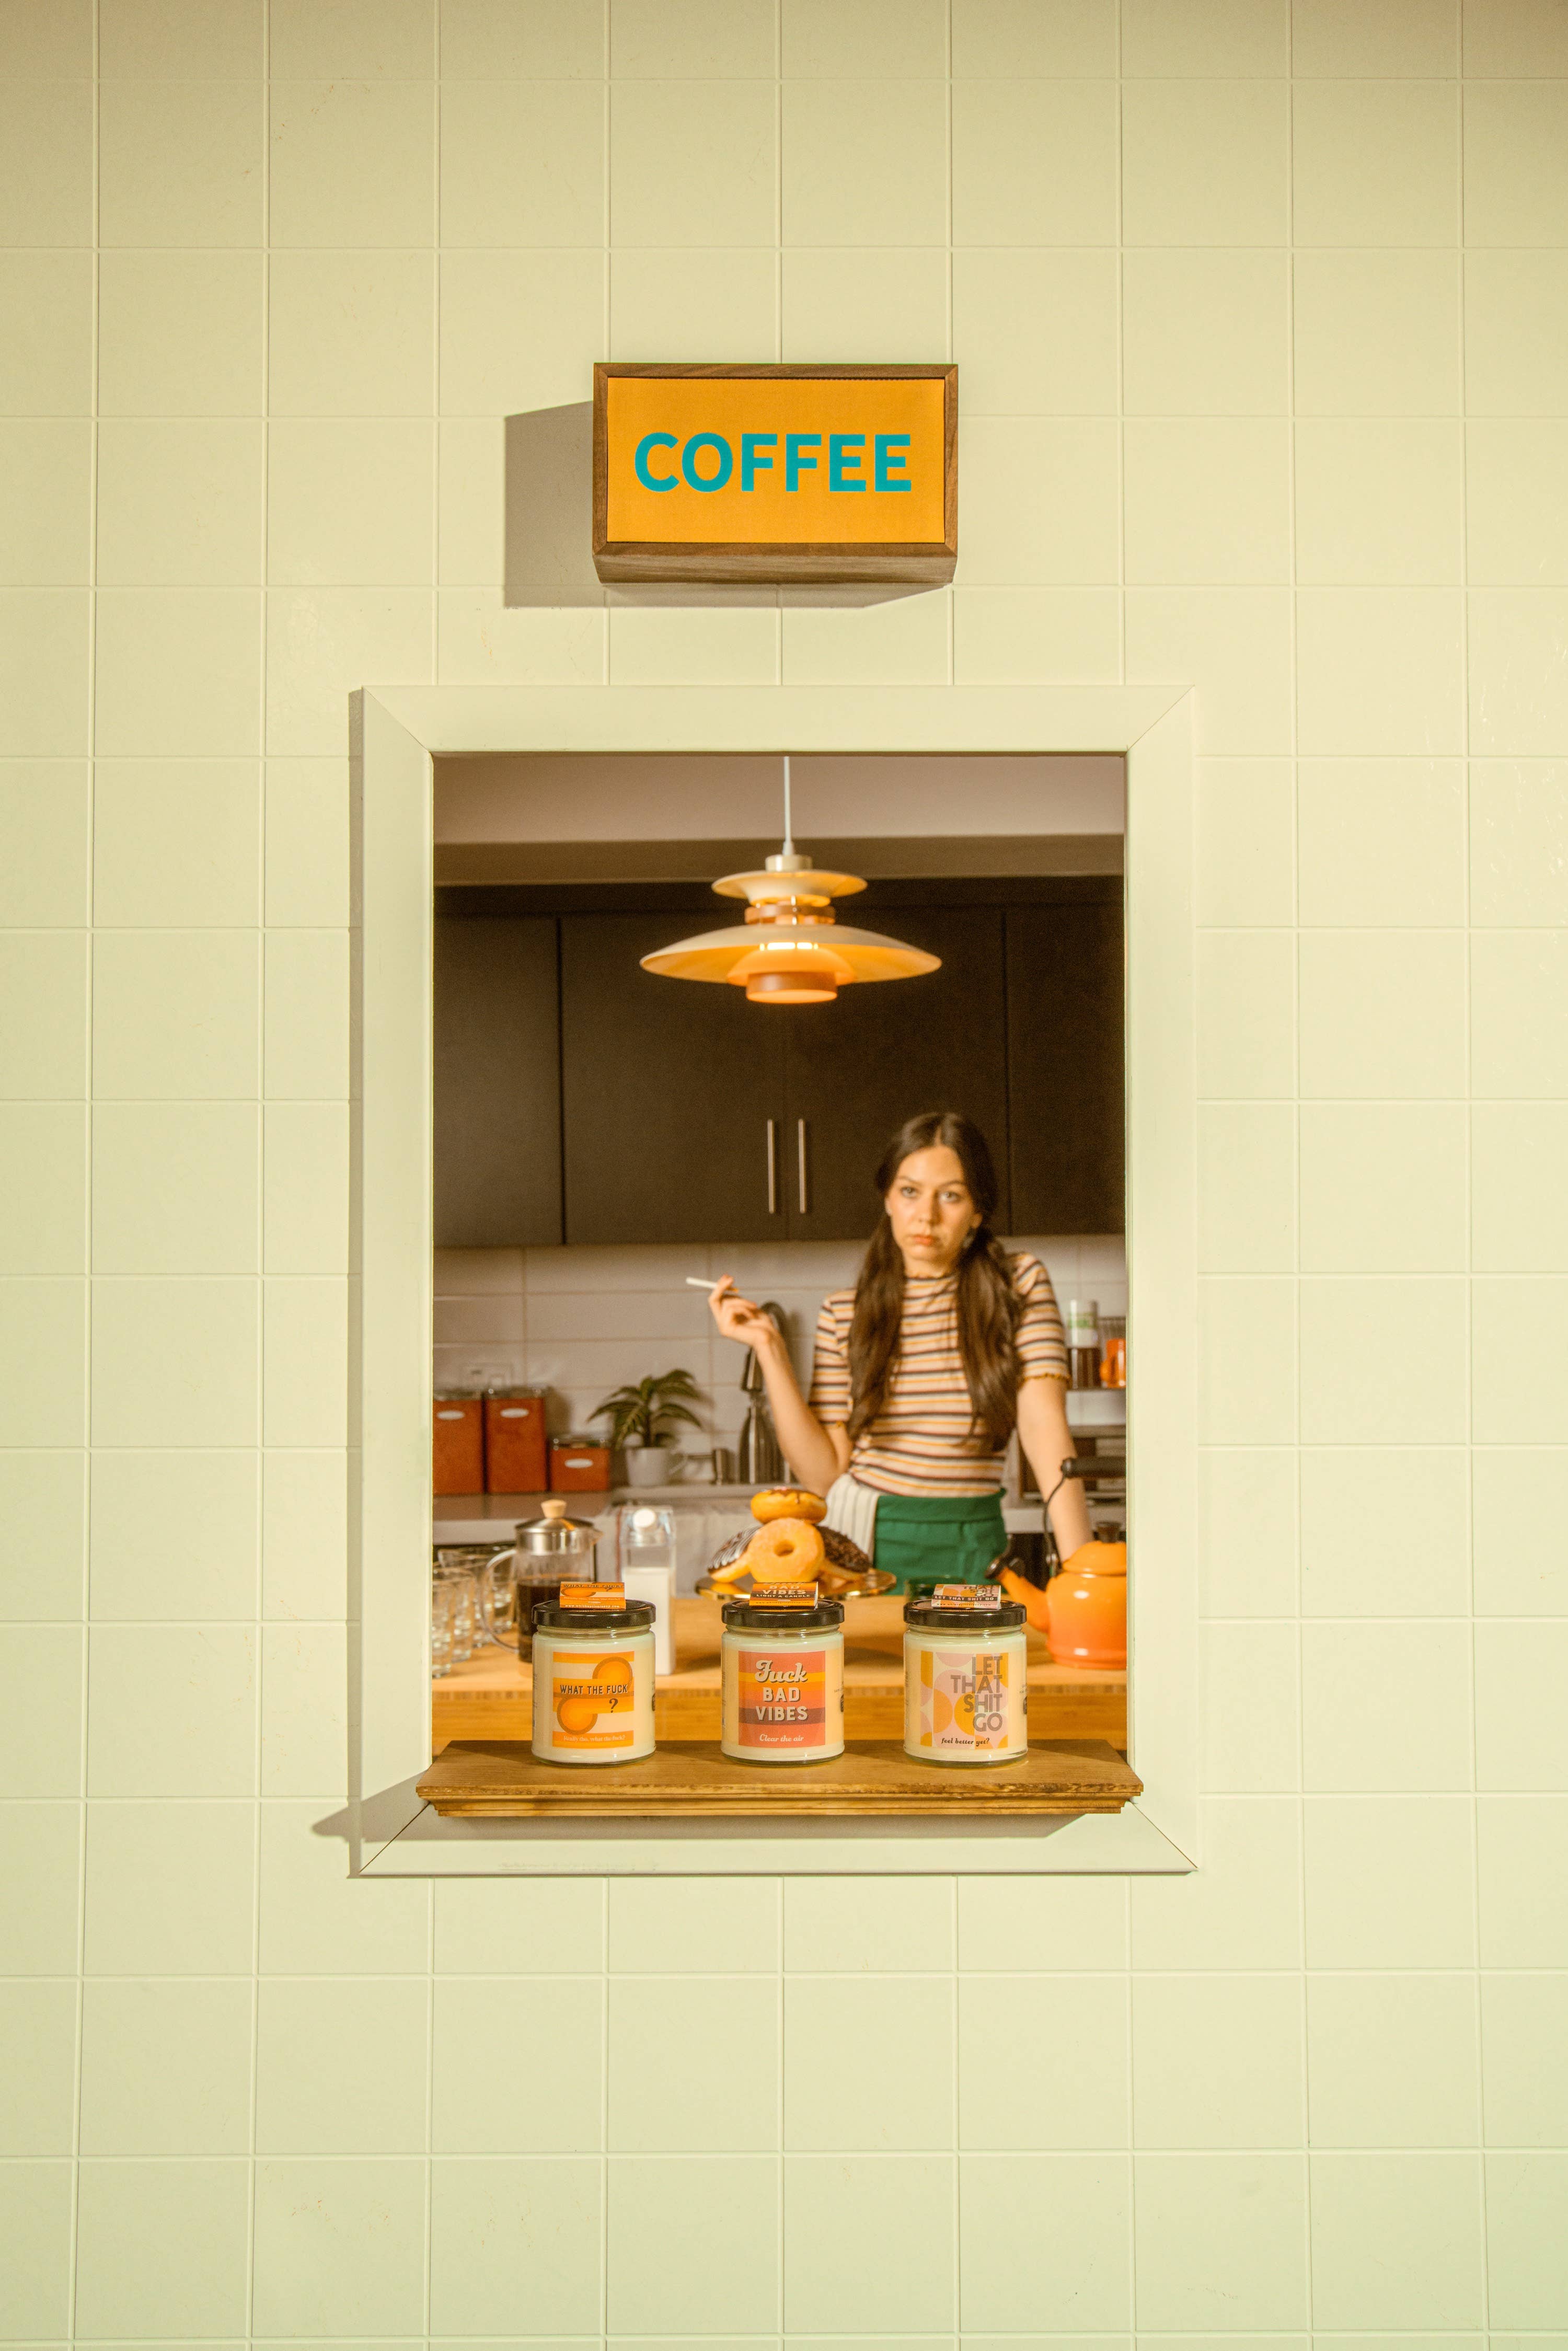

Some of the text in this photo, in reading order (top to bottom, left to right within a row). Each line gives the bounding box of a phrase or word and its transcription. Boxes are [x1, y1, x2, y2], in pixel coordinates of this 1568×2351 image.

[635, 432, 912, 492] COFFEE
[755, 1659, 808, 1683] Fuck
[972, 1655, 1002, 1675] LET
[560, 1684, 628, 1695] WHAT THE FUCK
[950, 1675, 1002, 1693] THAT
[763, 1687, 801, 1702] BAD
[963, 1693, 1002, 1713] SHIT
[609, 1698, 618, 1713] ?
[756, 1705, 809, 1721] VIBES
[973, 1712, 1002, 1732] GO
[759, 1733, 779, 1742] Clear
[976, 1737, 990, 1747] yet?
